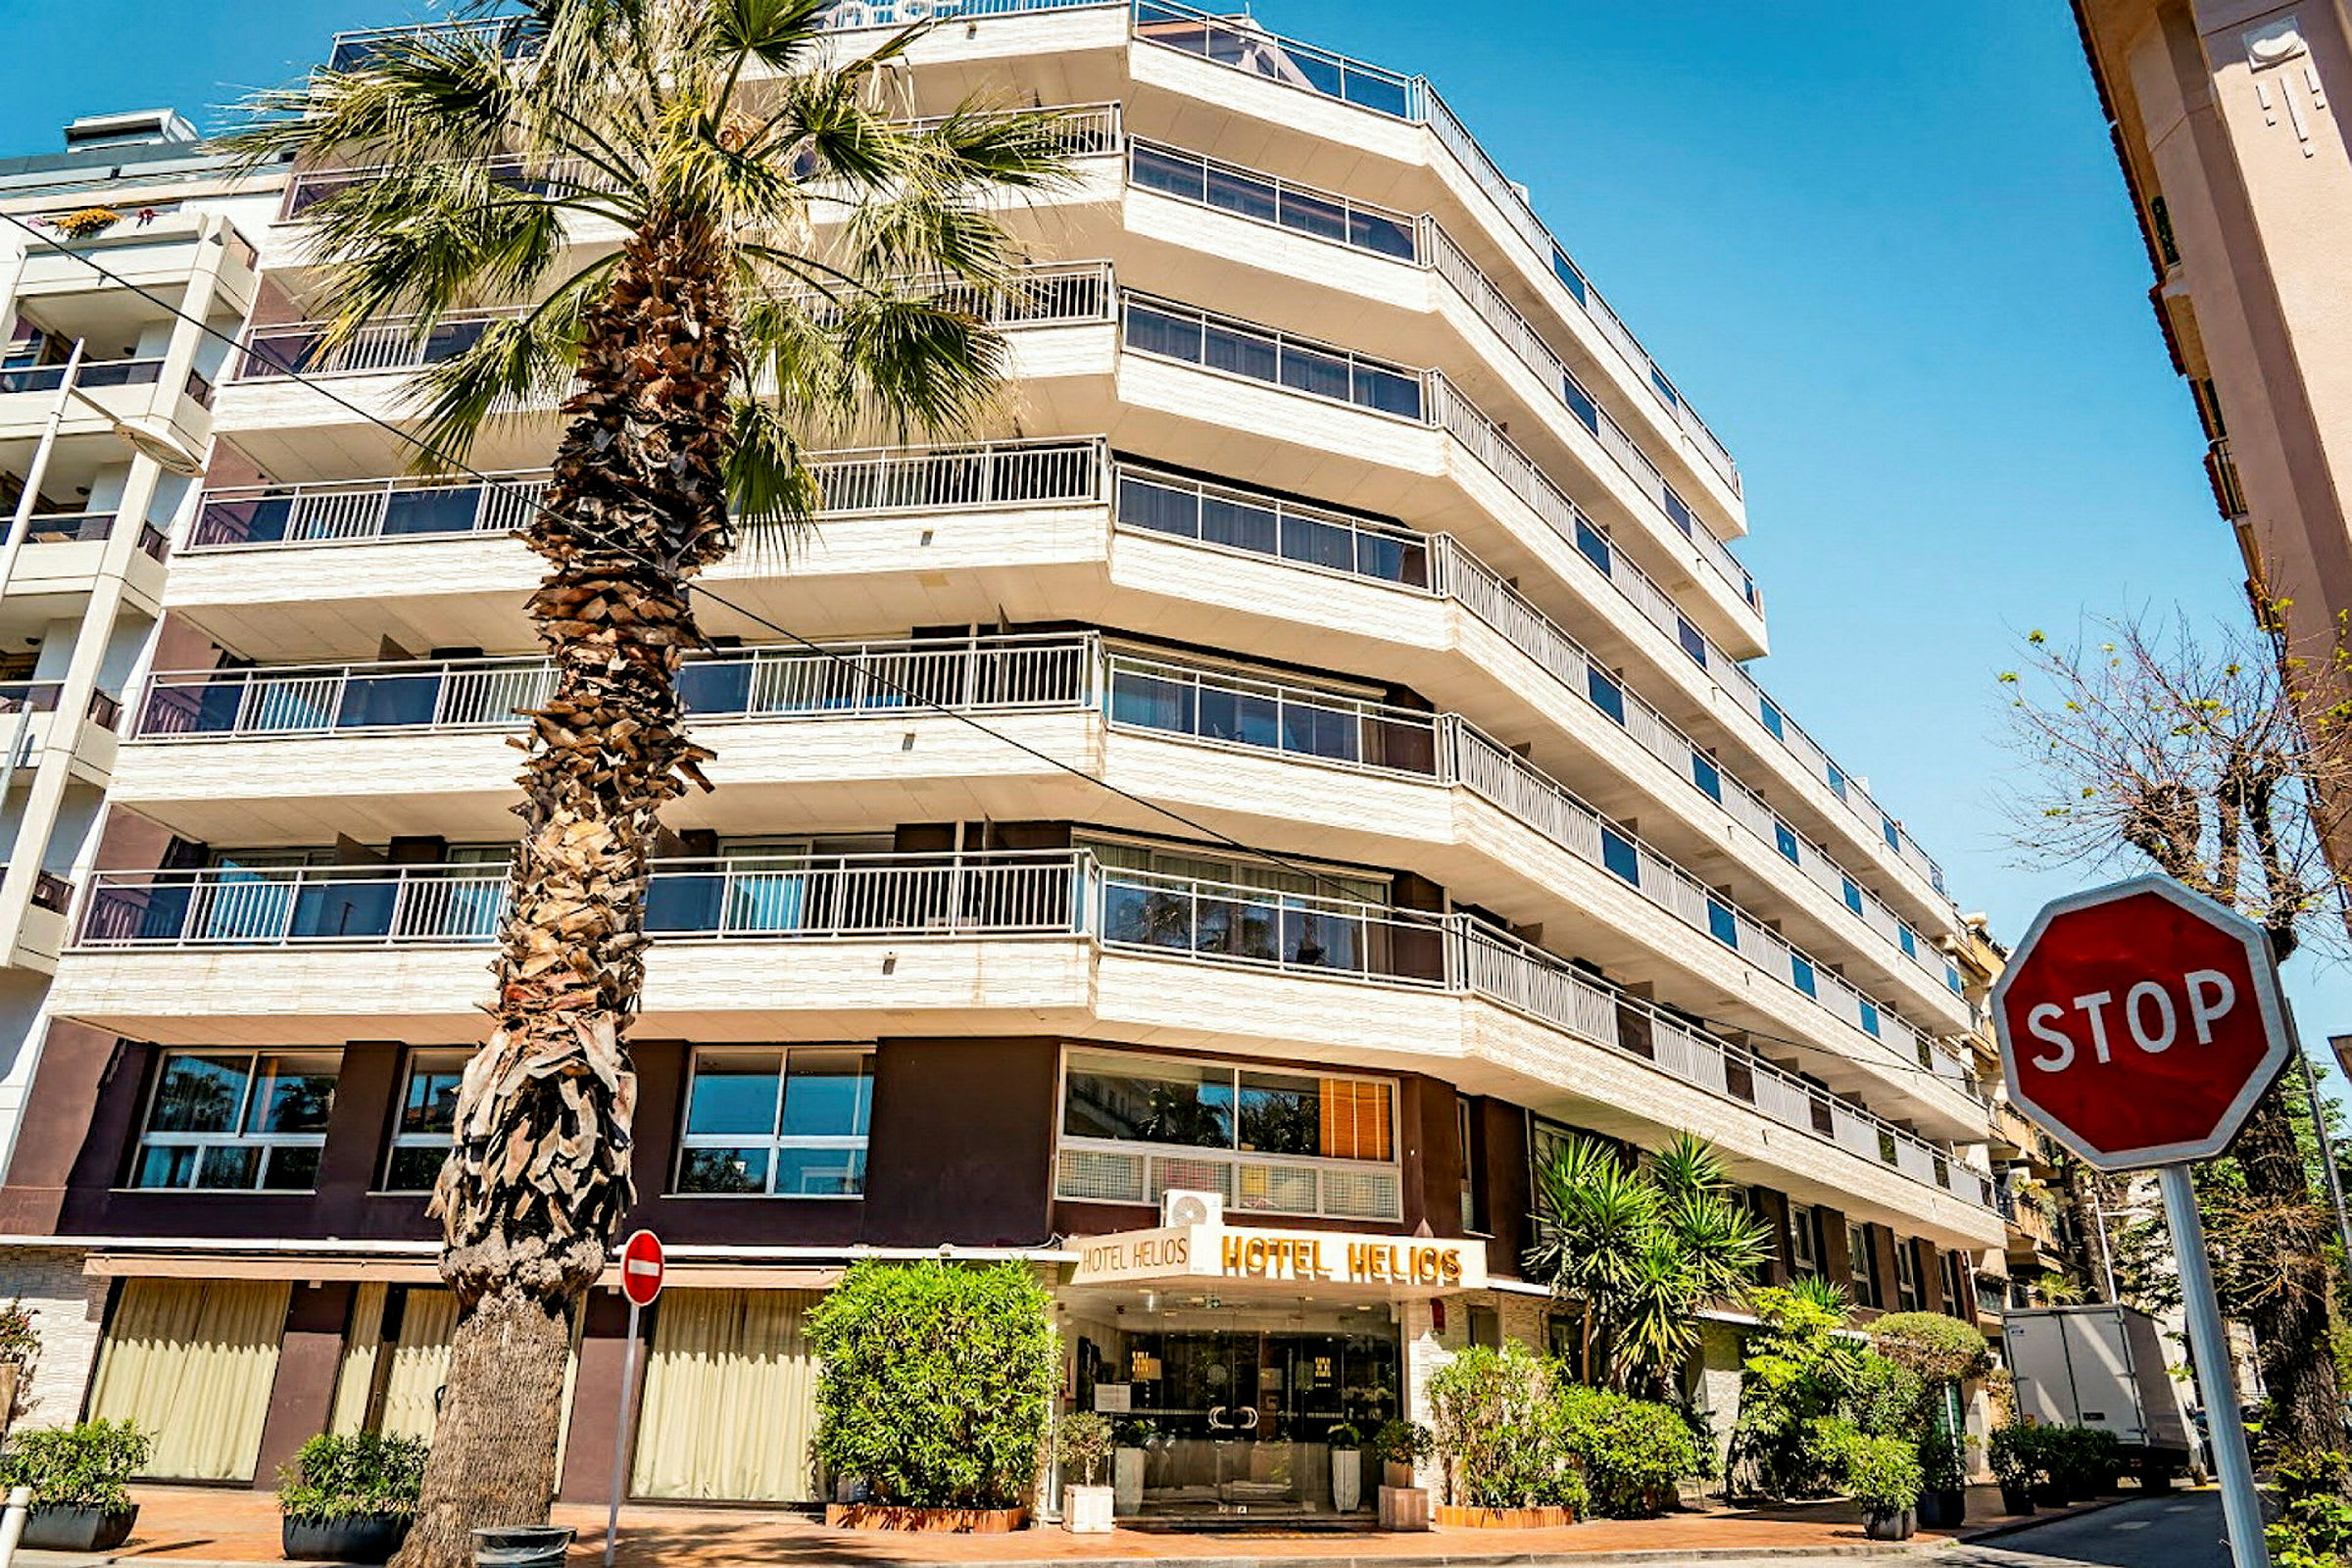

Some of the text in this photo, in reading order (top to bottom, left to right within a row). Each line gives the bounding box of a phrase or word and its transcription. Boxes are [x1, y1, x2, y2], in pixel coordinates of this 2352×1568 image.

[2028, 968, 2236, 1073] STOP
[1083, 1237, 1188, 1273] HOTEL HELIOS
[1222, 1236, 1462, 1278] HOTEL HELIOS
